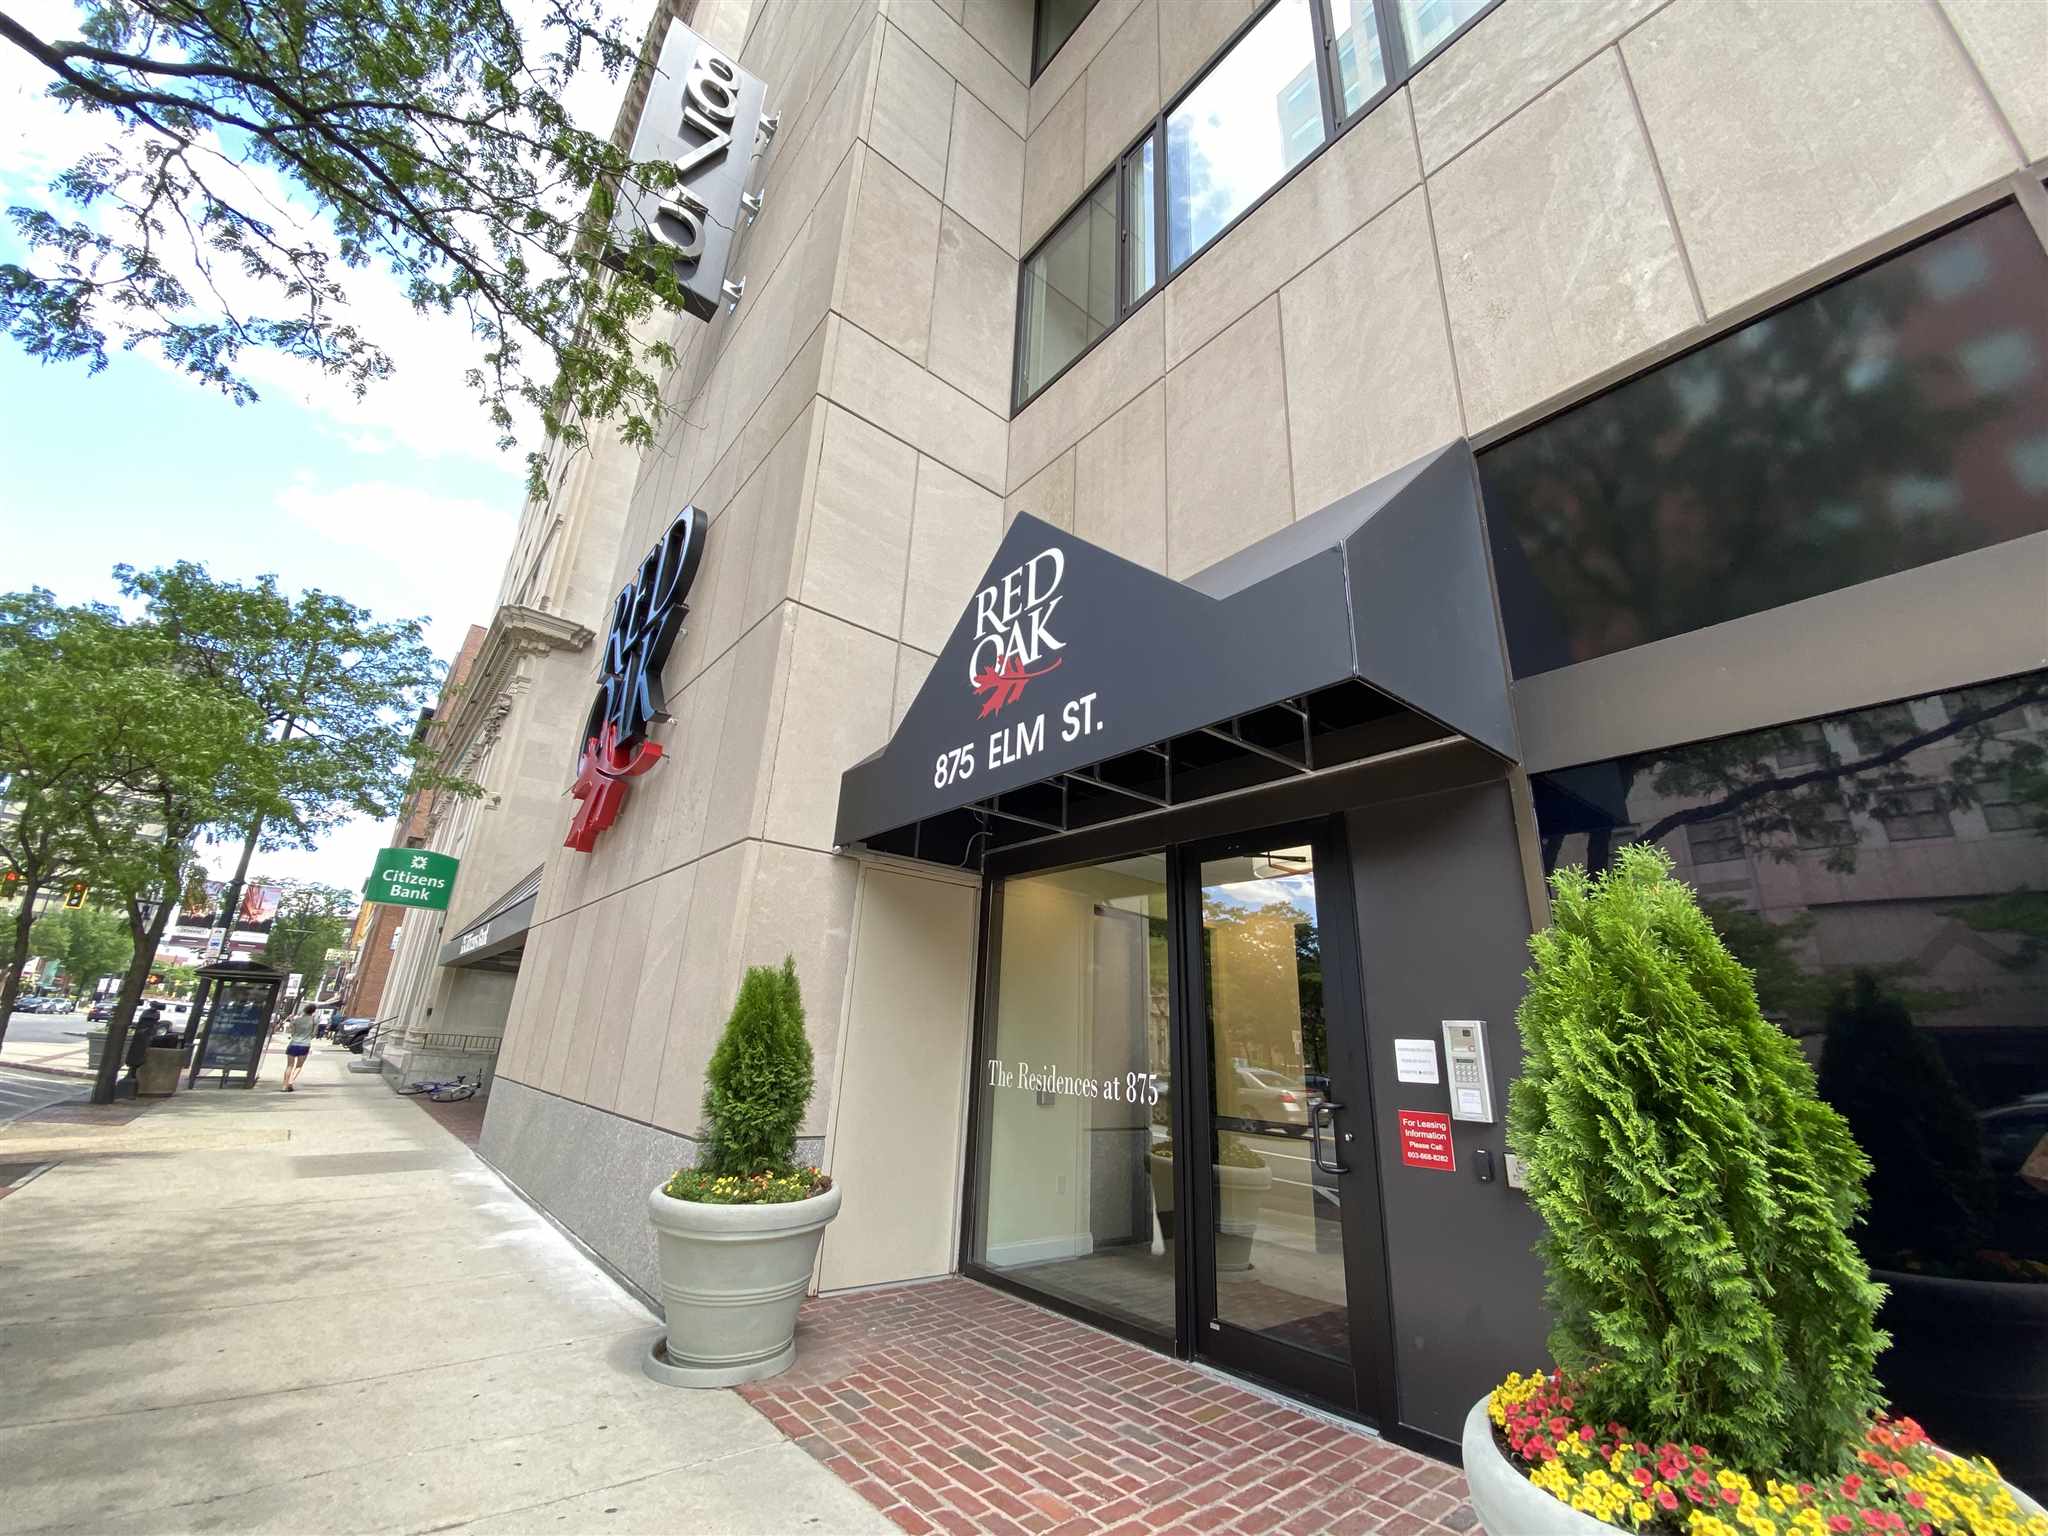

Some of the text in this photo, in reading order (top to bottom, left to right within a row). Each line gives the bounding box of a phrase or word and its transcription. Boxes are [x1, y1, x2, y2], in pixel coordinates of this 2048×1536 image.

[596, 505, 707, 684] RED
[973, 547, 1065, 640] RED
[969, 595, 1067, 688] OAK
[577, 603, 689, 776] OAK
[934, 692, 1103, 789] 875 ELM ST.
[382, 869, 446, 888] Citizens
[389, 884, 431, 901] Bank
[988, 1059, 1159, 1106] The Residences at 875
[1402, 1118, 1447, 1131] For Leasing
[1405, 1129, 1447, 1140] Information
[1408, 1141, 1430, 1150] Please
